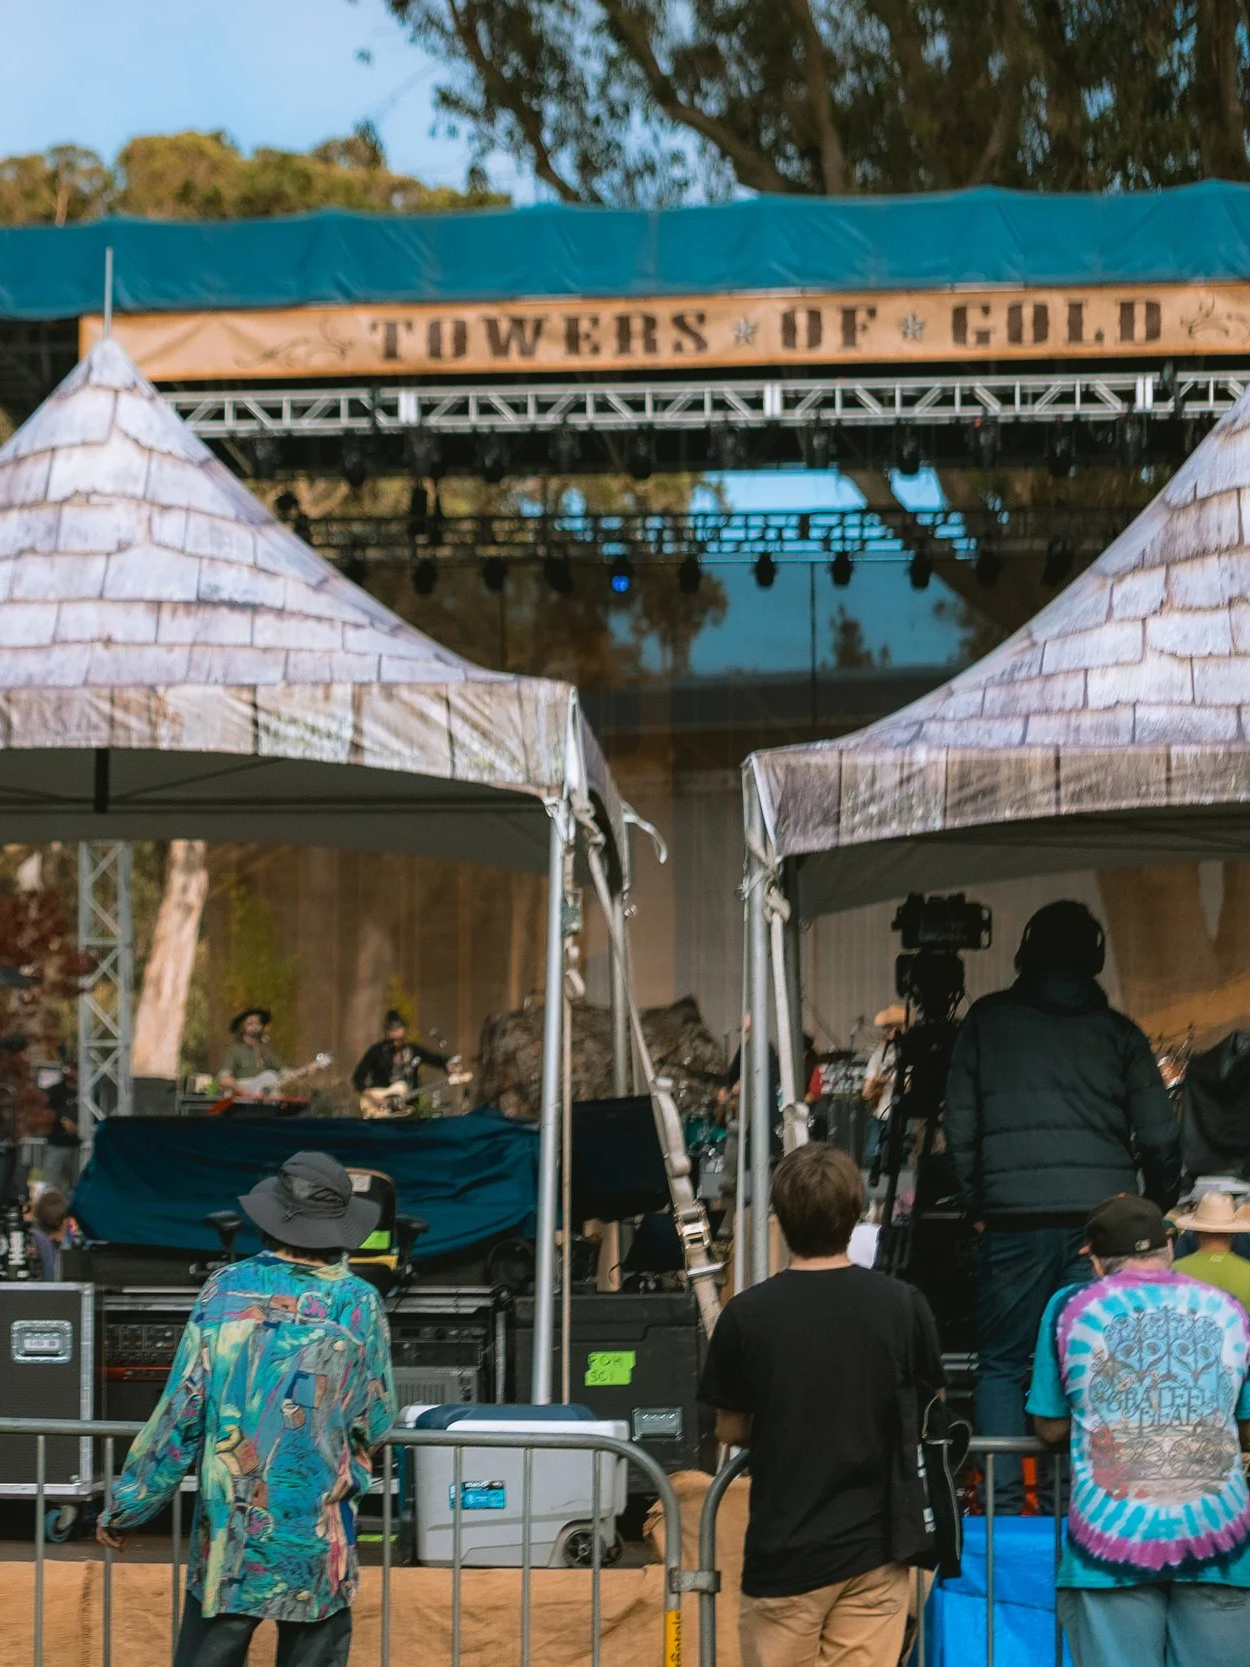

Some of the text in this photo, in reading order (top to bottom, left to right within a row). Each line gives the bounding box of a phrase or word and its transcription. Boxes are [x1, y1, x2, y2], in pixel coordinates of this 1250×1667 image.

[369, 299, 1162, 361] TOWERS OF GOLD
